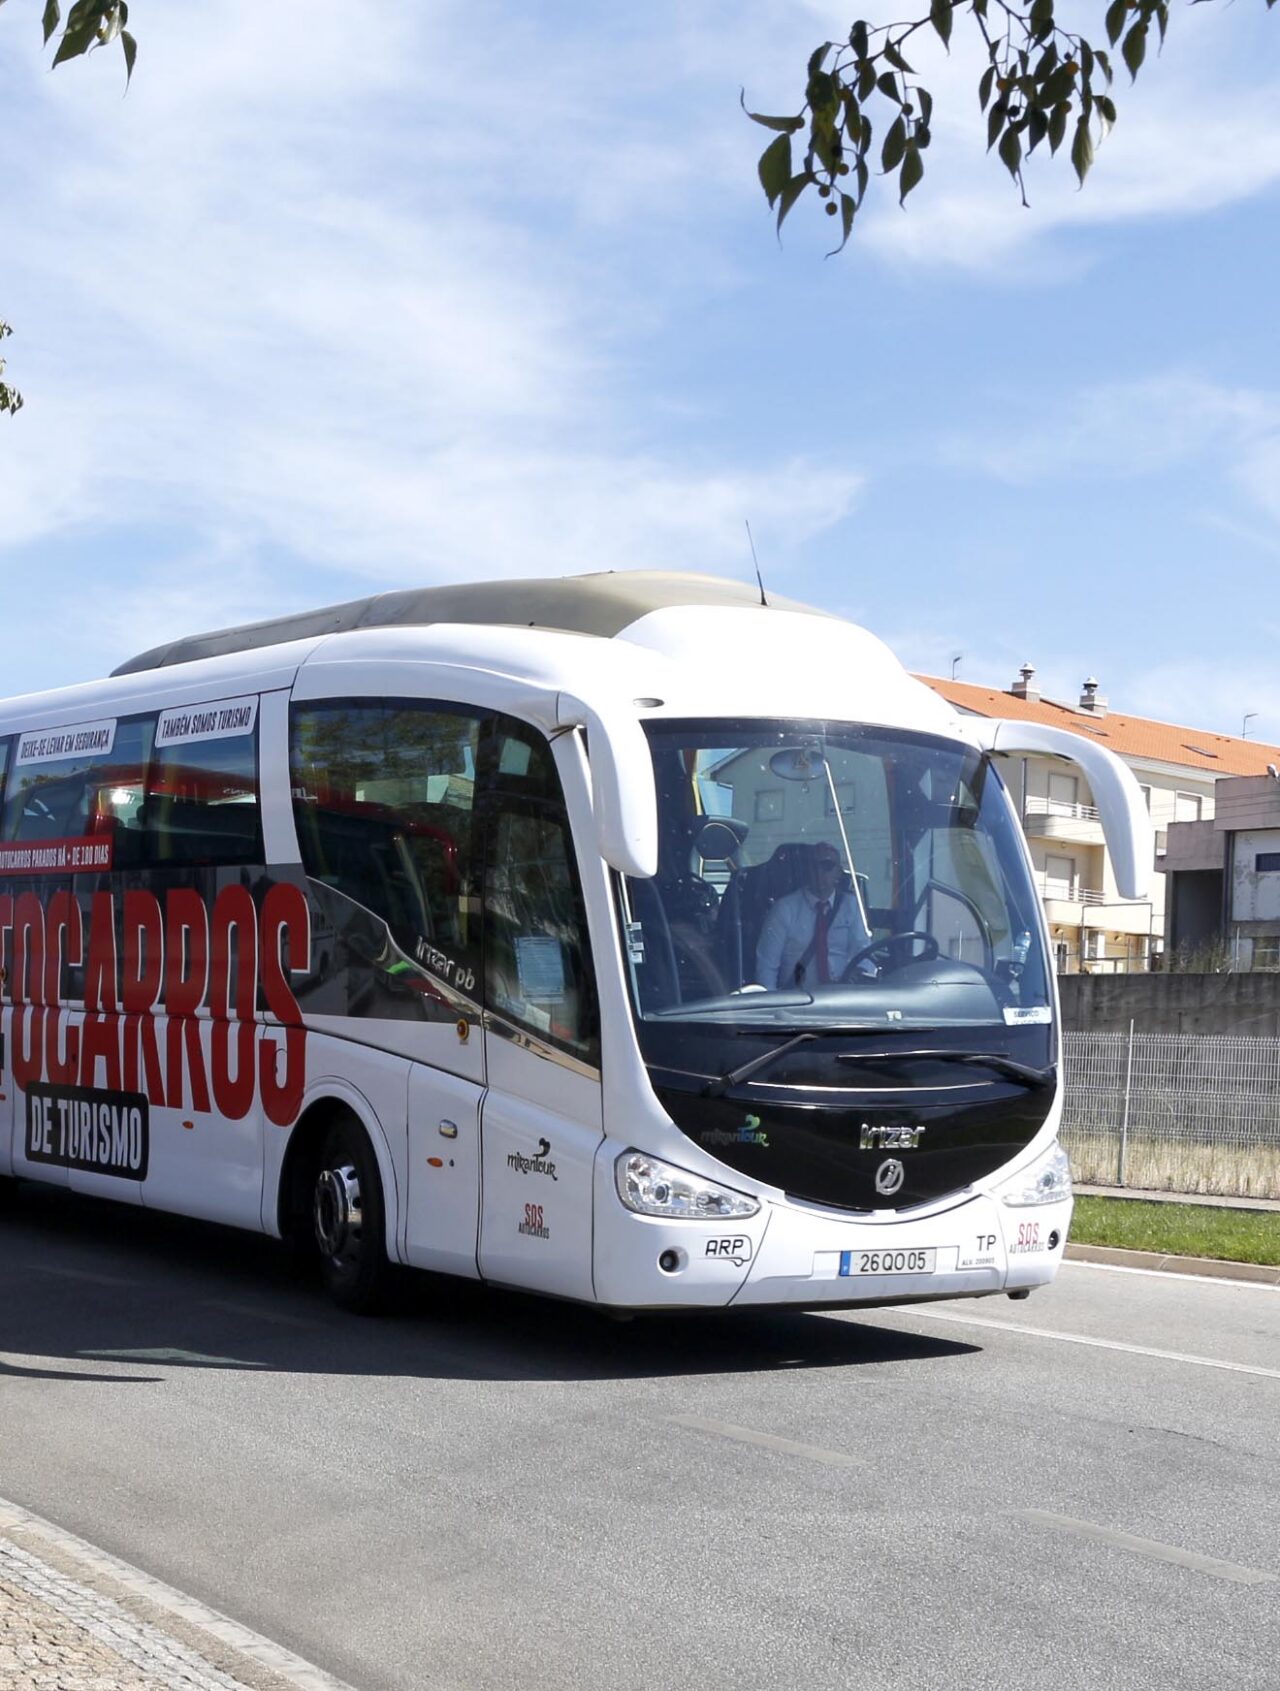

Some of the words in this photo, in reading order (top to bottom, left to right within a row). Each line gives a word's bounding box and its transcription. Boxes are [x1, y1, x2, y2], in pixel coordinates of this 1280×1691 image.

[162, 714, 191, 738] TAMBÉM
[191, 712, 217, 734] SOMOS
[218, 706, 251, 730] TURISMO
[21, 737, 46, 759] DEIXE-SE
[46, 736, 65, 755] LEVAR
[64, 734, 76, 752] EM
[75, 729, 110, 751] SEGURANÇA
[31, 848, 57, 868] PARADOS
[72, 847, 81, 865] DE
[94, 844, 110, 865] DIAS
[455, 967, 475, 990] pb
[30, 1095, 53, 1153] DE
[58, 1104, 143, 1171] TURISMO
[524, 1203, 545, 1227] SOS
[976, 1234, 997, 1251] TP
[1018, 1223, 1039, 1245] SOS
[705, 1239, 744, 1256] ARP
